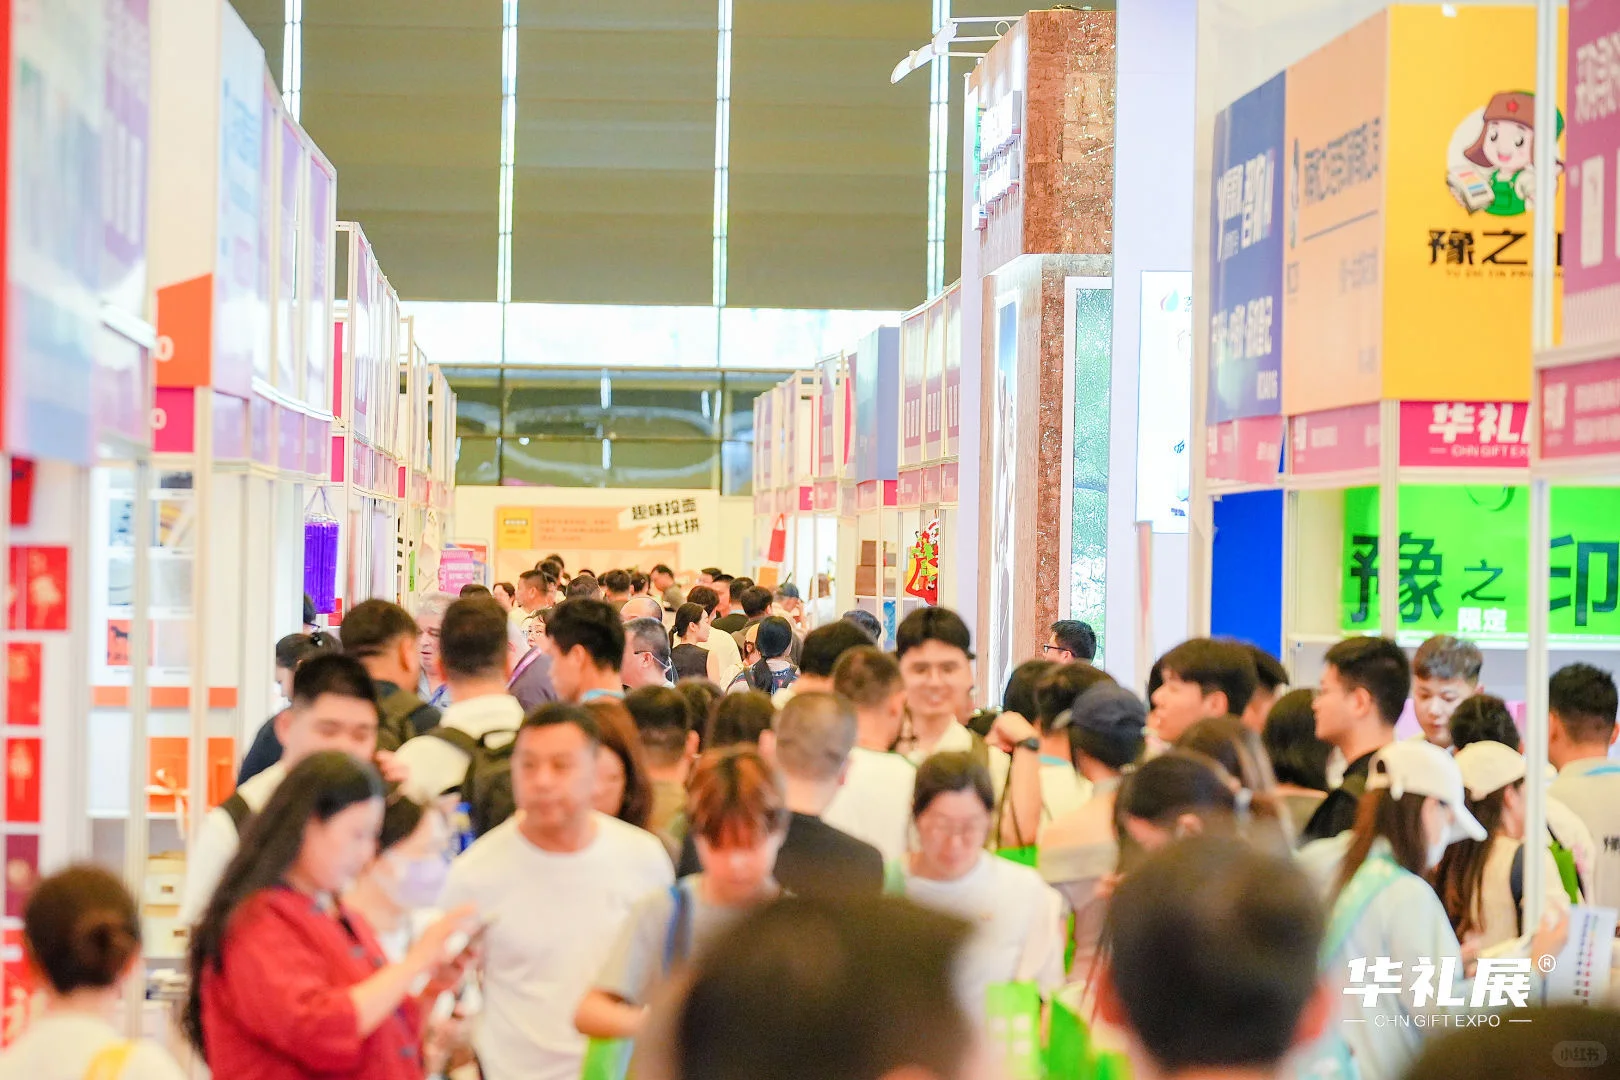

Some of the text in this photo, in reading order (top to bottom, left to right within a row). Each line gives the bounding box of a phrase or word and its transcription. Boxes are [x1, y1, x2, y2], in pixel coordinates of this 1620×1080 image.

[1428, 228, 1563, 266] 豫之
[1429, 403, 1528, 443] 华礼
[652, 517, 699, 539] 大比拼
